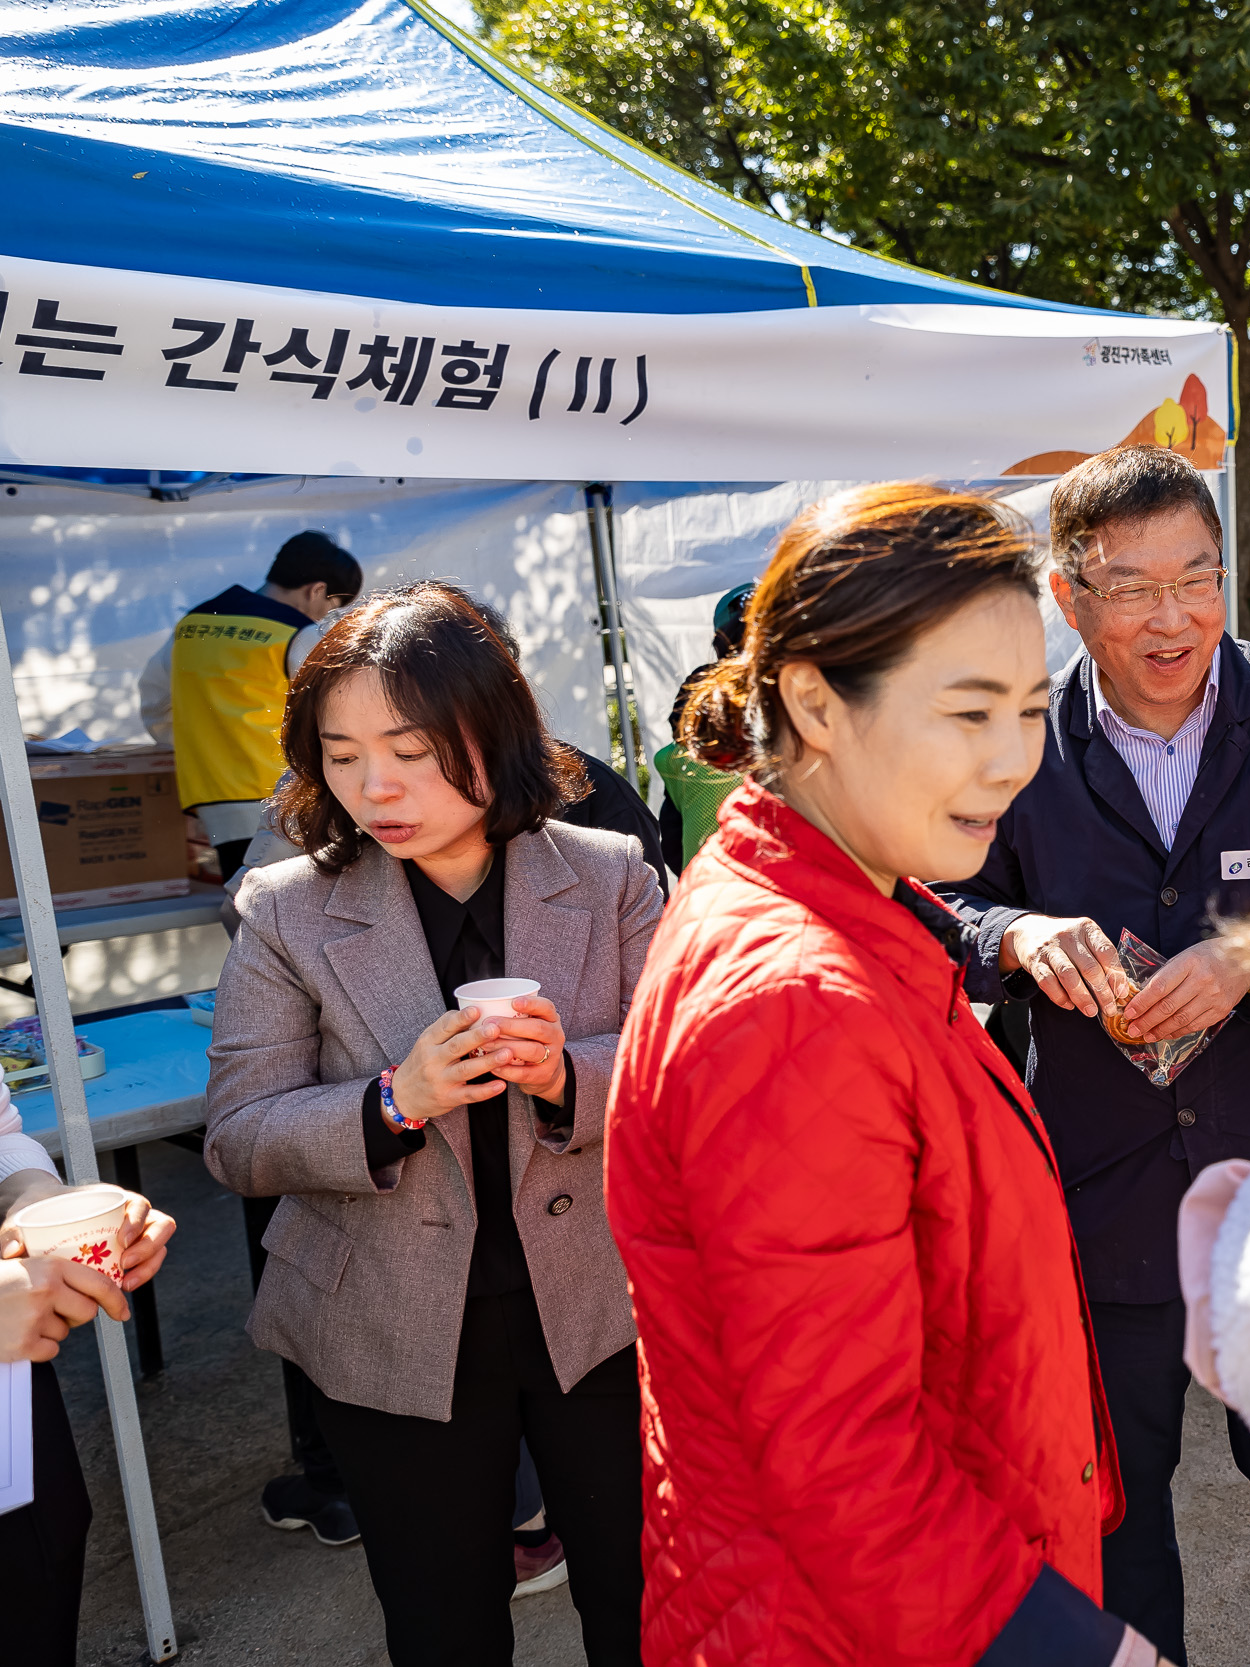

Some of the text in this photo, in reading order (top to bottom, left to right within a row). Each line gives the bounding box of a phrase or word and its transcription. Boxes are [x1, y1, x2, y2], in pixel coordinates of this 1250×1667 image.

[0, 290, 124, 381] 는
[161, 318, 510, 411] 간식체험
[1101, 344, 1172, 366] 광진구가족센터
